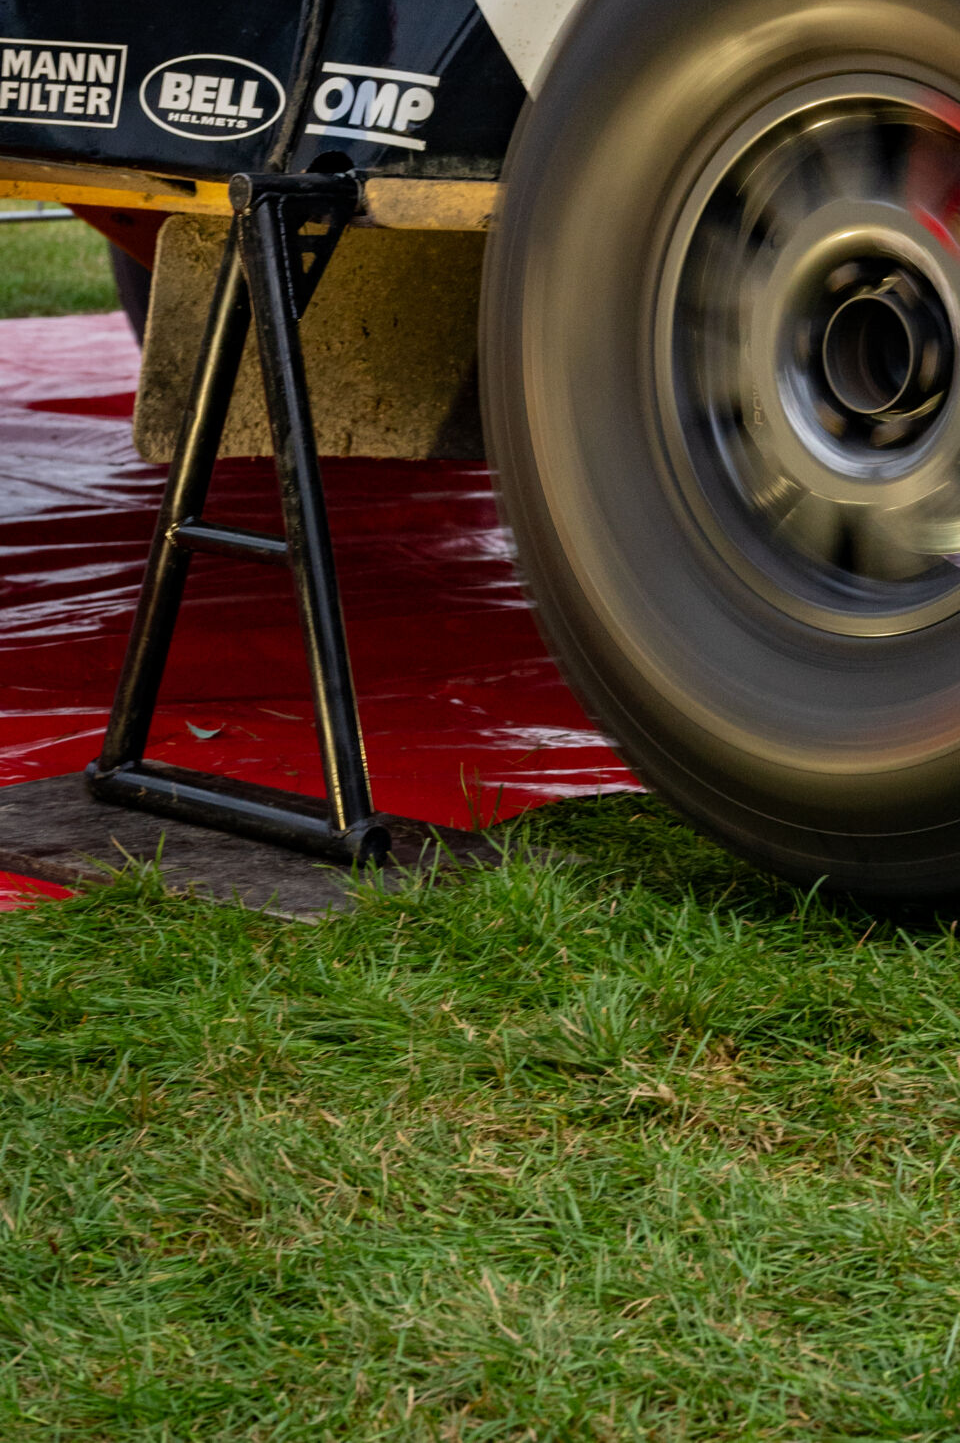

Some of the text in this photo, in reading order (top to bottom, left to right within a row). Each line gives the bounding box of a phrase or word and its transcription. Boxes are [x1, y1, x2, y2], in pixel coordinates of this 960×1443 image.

[1, 48, 117, 84] MANN
[0, 81, 112, 116] FILTER
[158, 71, 264, 119] BELL
[313, 75, 436, 132] OMP
[167, 112, 249, 129] HELMETS
